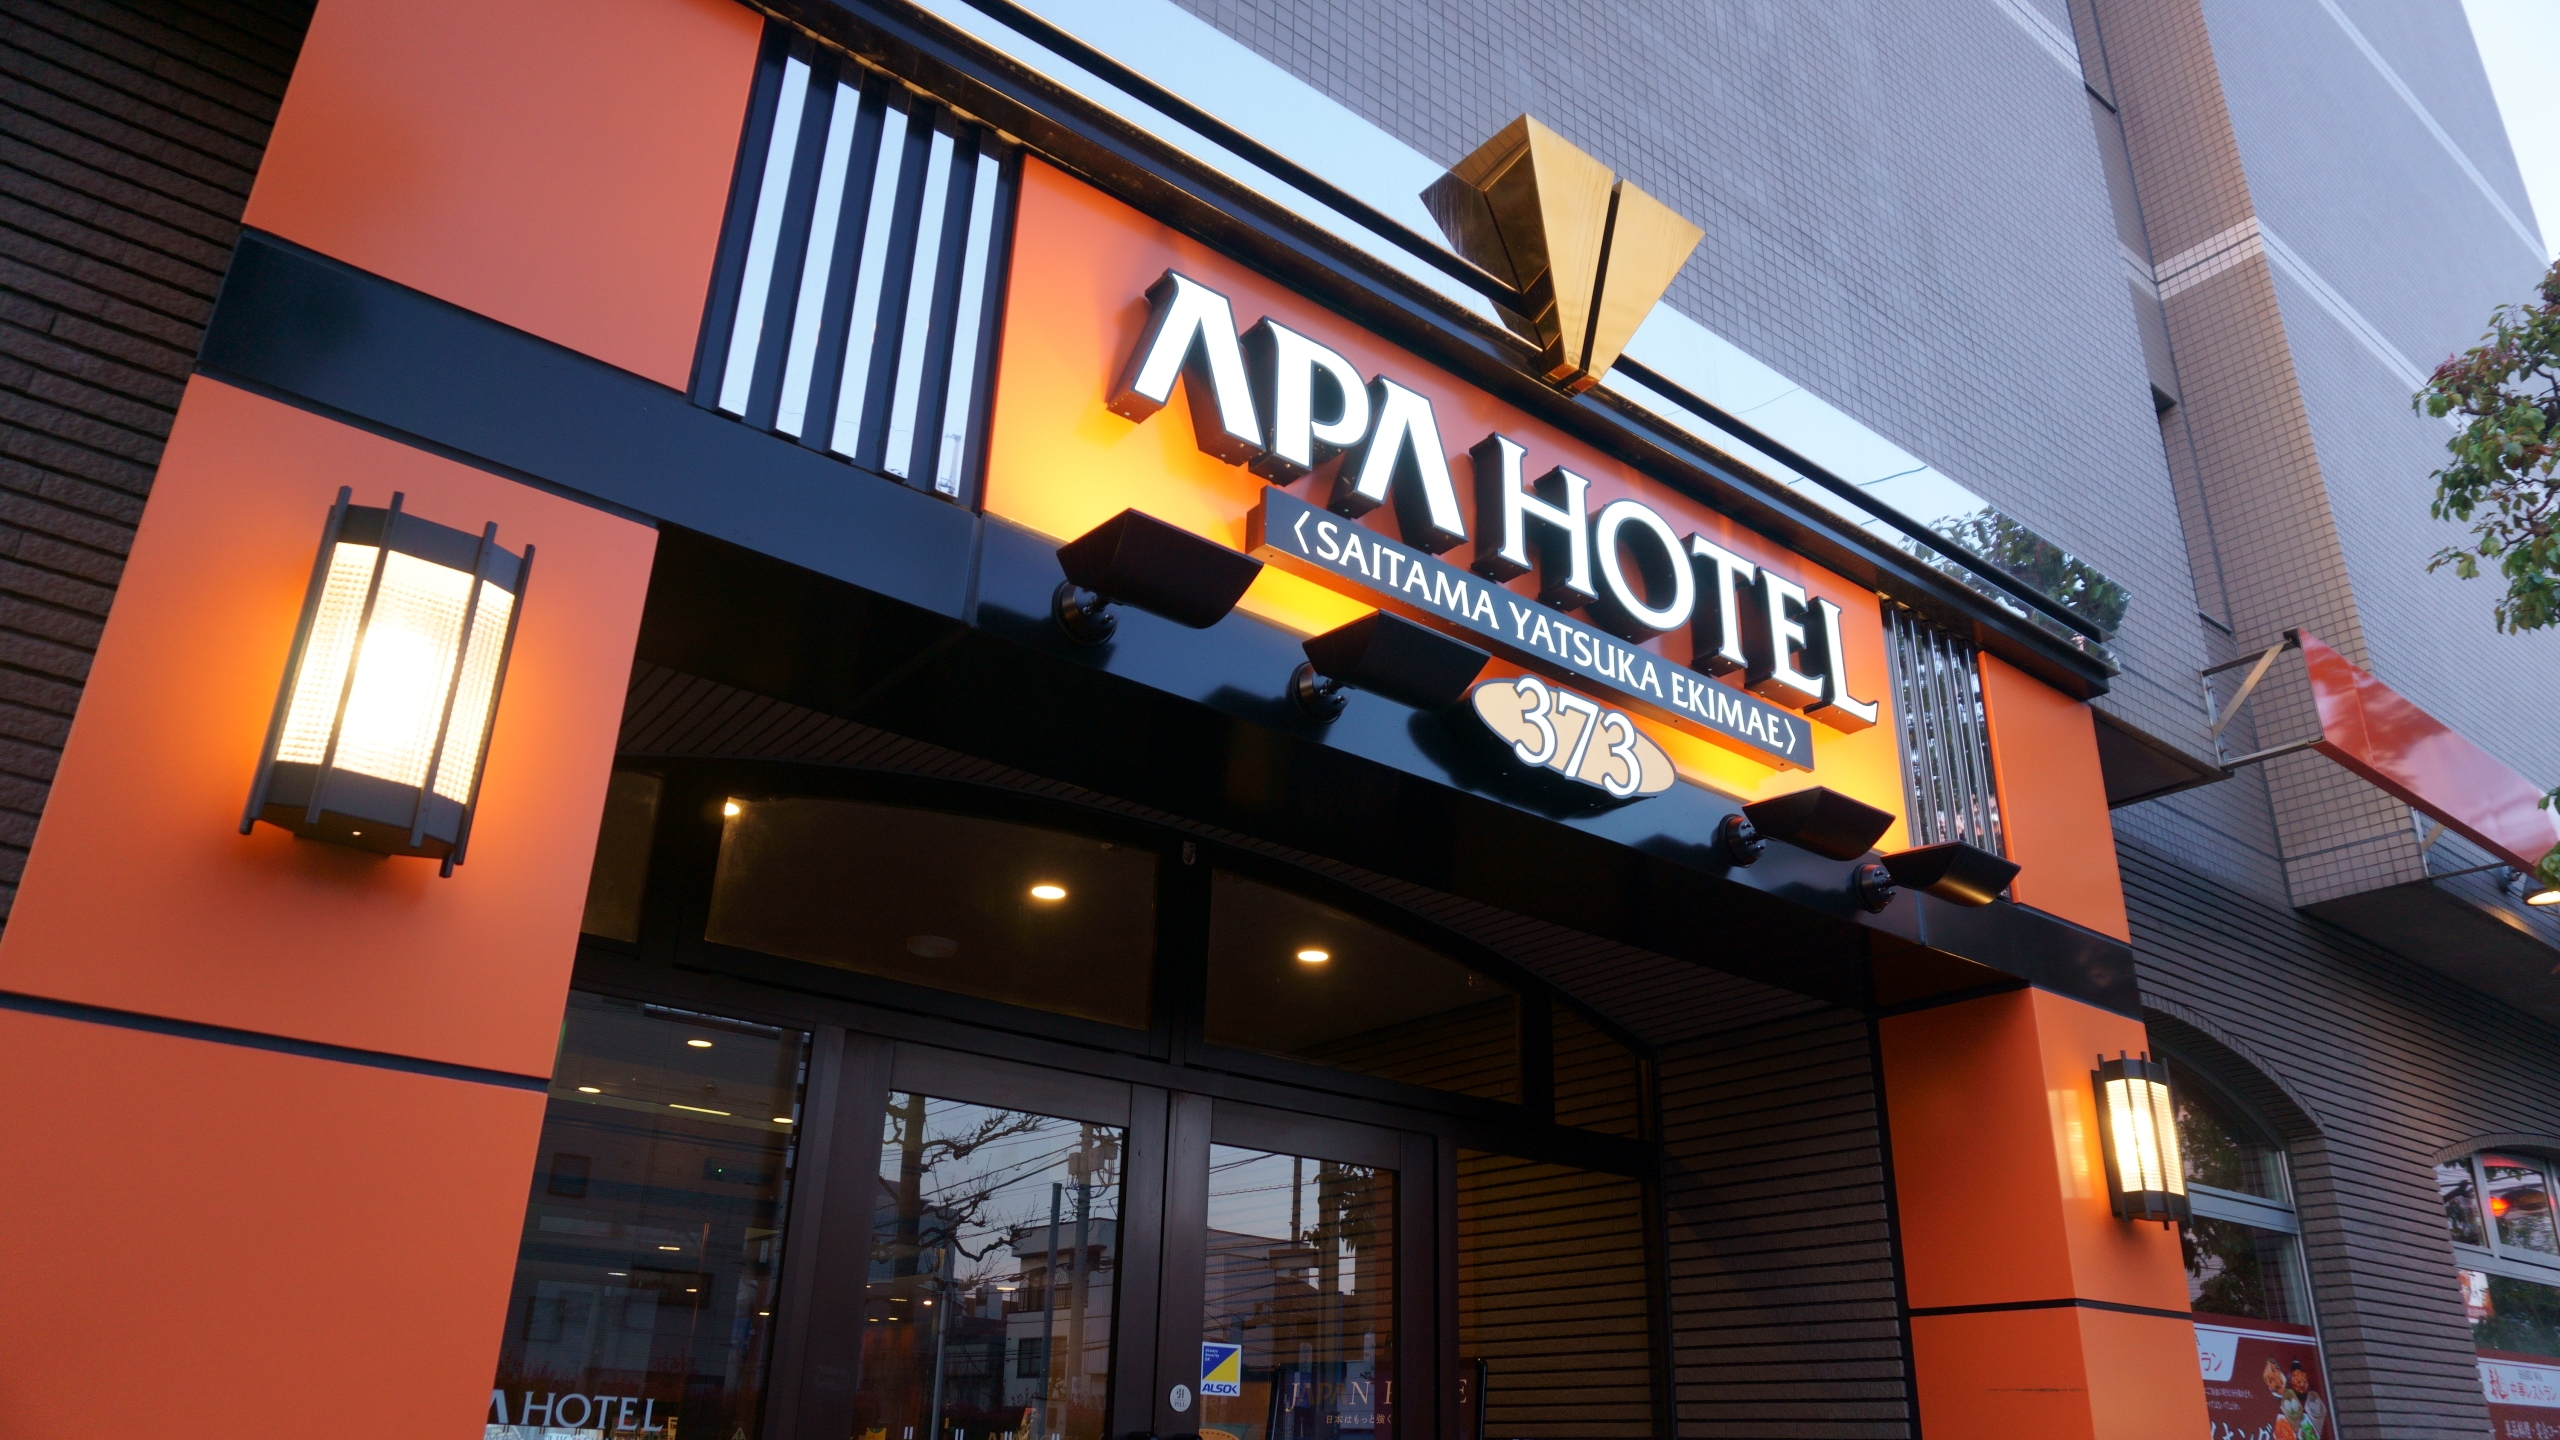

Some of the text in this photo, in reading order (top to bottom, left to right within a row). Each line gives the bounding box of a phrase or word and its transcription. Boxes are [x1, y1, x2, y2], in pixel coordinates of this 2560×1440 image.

[1131, 267, 1880, 726] APA HOTEL
[1506, 599, 1667, 699] YATSUKA
[1508, 674, 1645, 800] 373
[520, 1391, 664, 1432] HOTEL
[1176, 1388, 1185, 1399] 引
[1202, 1383, 1238, 1394] ALSOK
